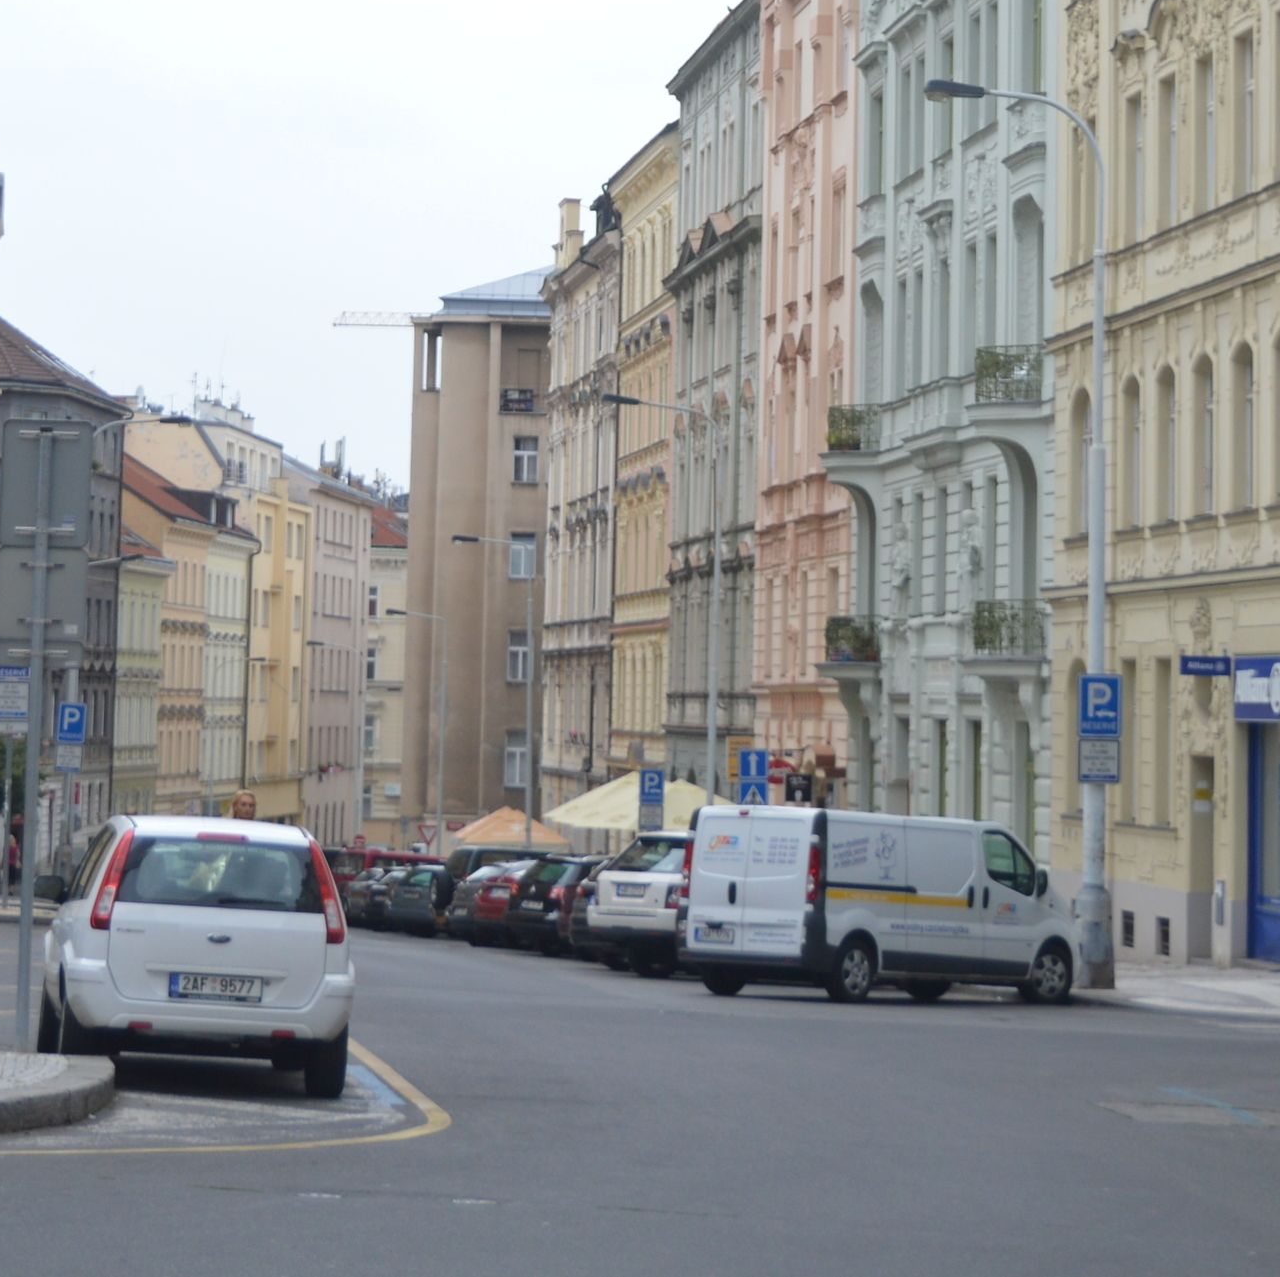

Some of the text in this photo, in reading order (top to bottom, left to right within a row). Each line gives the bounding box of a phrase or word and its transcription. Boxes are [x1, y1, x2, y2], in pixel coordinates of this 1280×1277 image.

[1087, 682, 1113, 717] P
[63, 706, 81, 731] P
[182, 976, 255, 994] 2AF 9577
